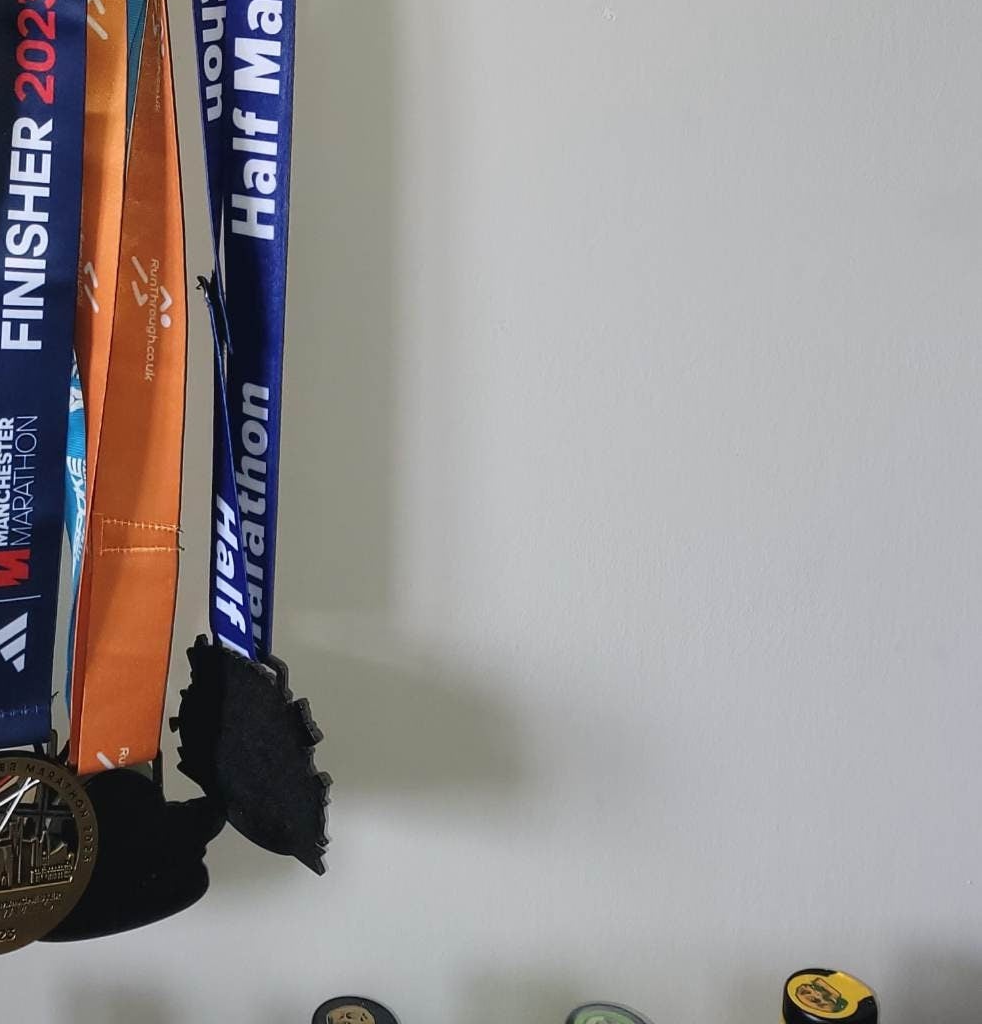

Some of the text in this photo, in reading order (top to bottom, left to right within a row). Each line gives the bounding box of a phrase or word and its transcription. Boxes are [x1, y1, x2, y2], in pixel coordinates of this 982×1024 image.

[0, 116, 53, 350] FINISHER
[231, 107, 279, 241] Half
[13, 414, 38, 547] MARATHON
[235, 382, 270, 652] arathon
[215, 493, 247, 635] Half
